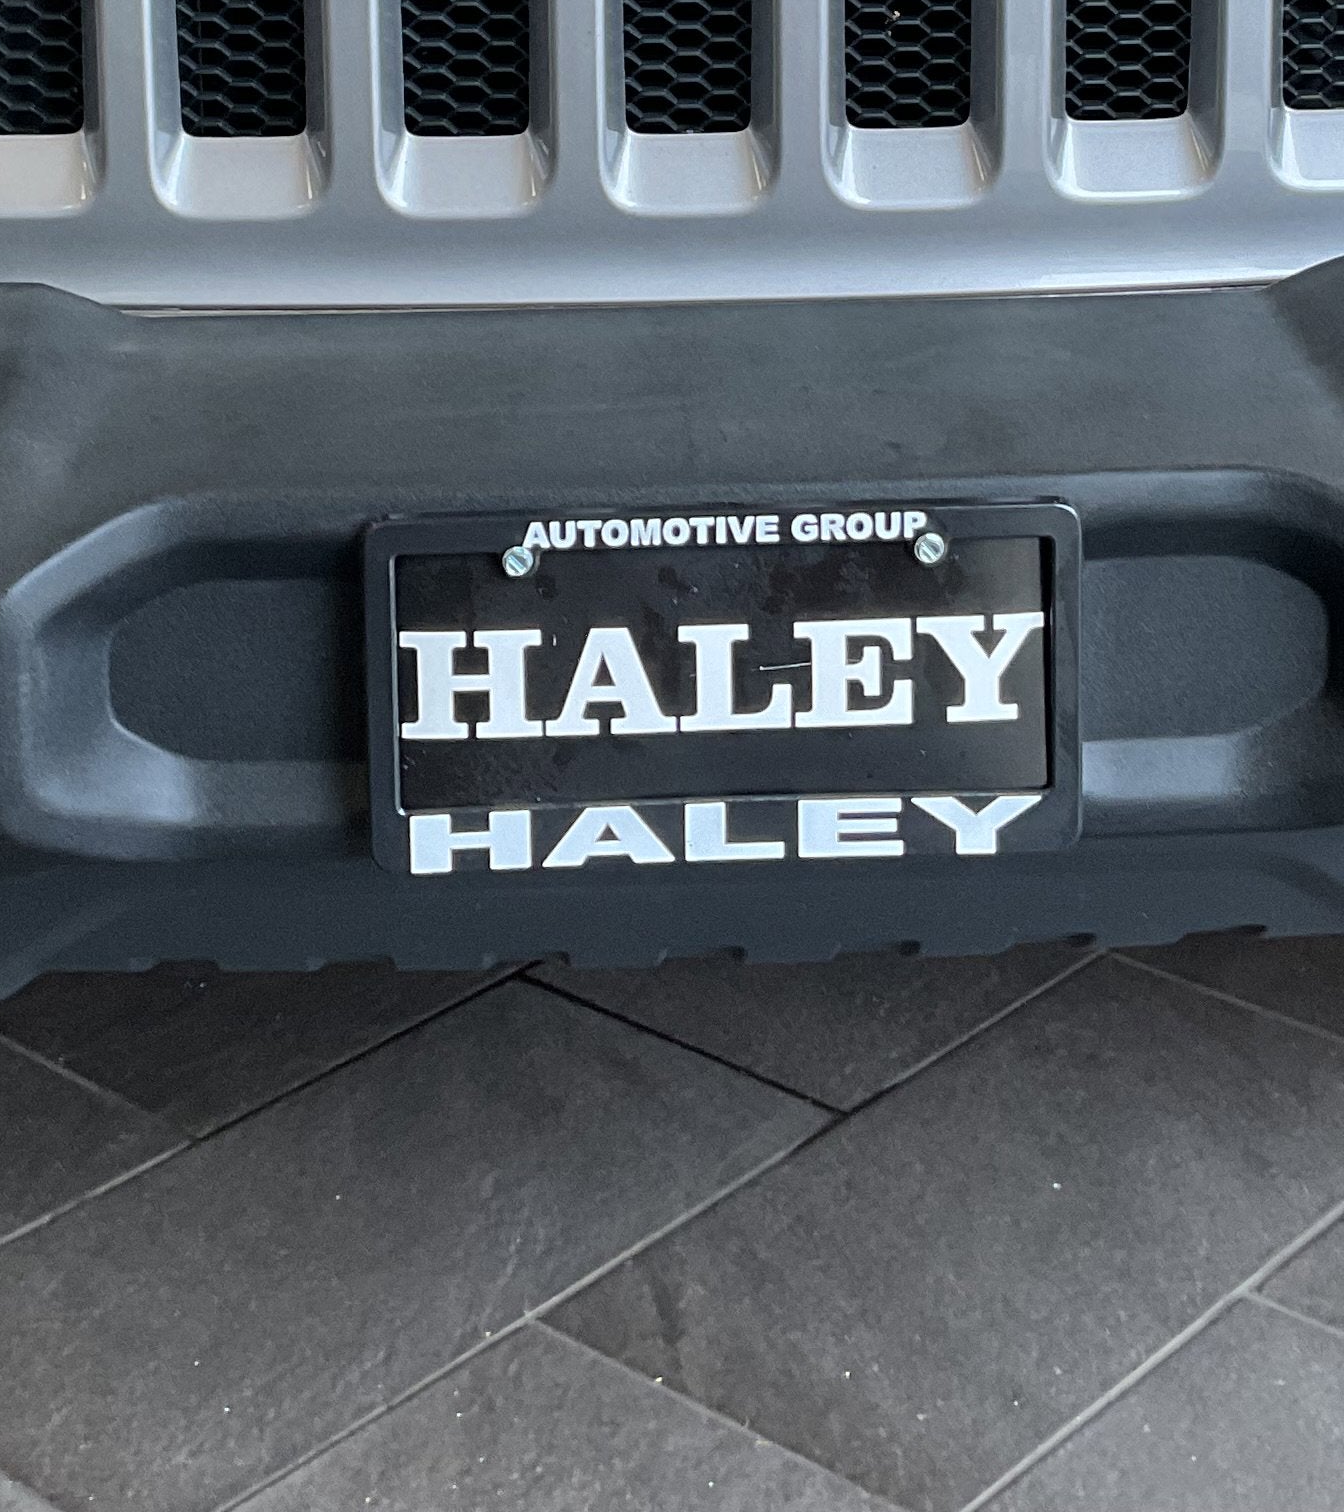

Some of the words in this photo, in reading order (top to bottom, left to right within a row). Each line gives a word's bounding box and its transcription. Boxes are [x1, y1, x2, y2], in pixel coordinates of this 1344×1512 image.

[522, 515, 780, 550] AUTOMOTIVE
[791, 511, 928, 541] GROUP
[398, 610, 1045, 740] HALEY
[408, 794, 1044, 875] HALEY
